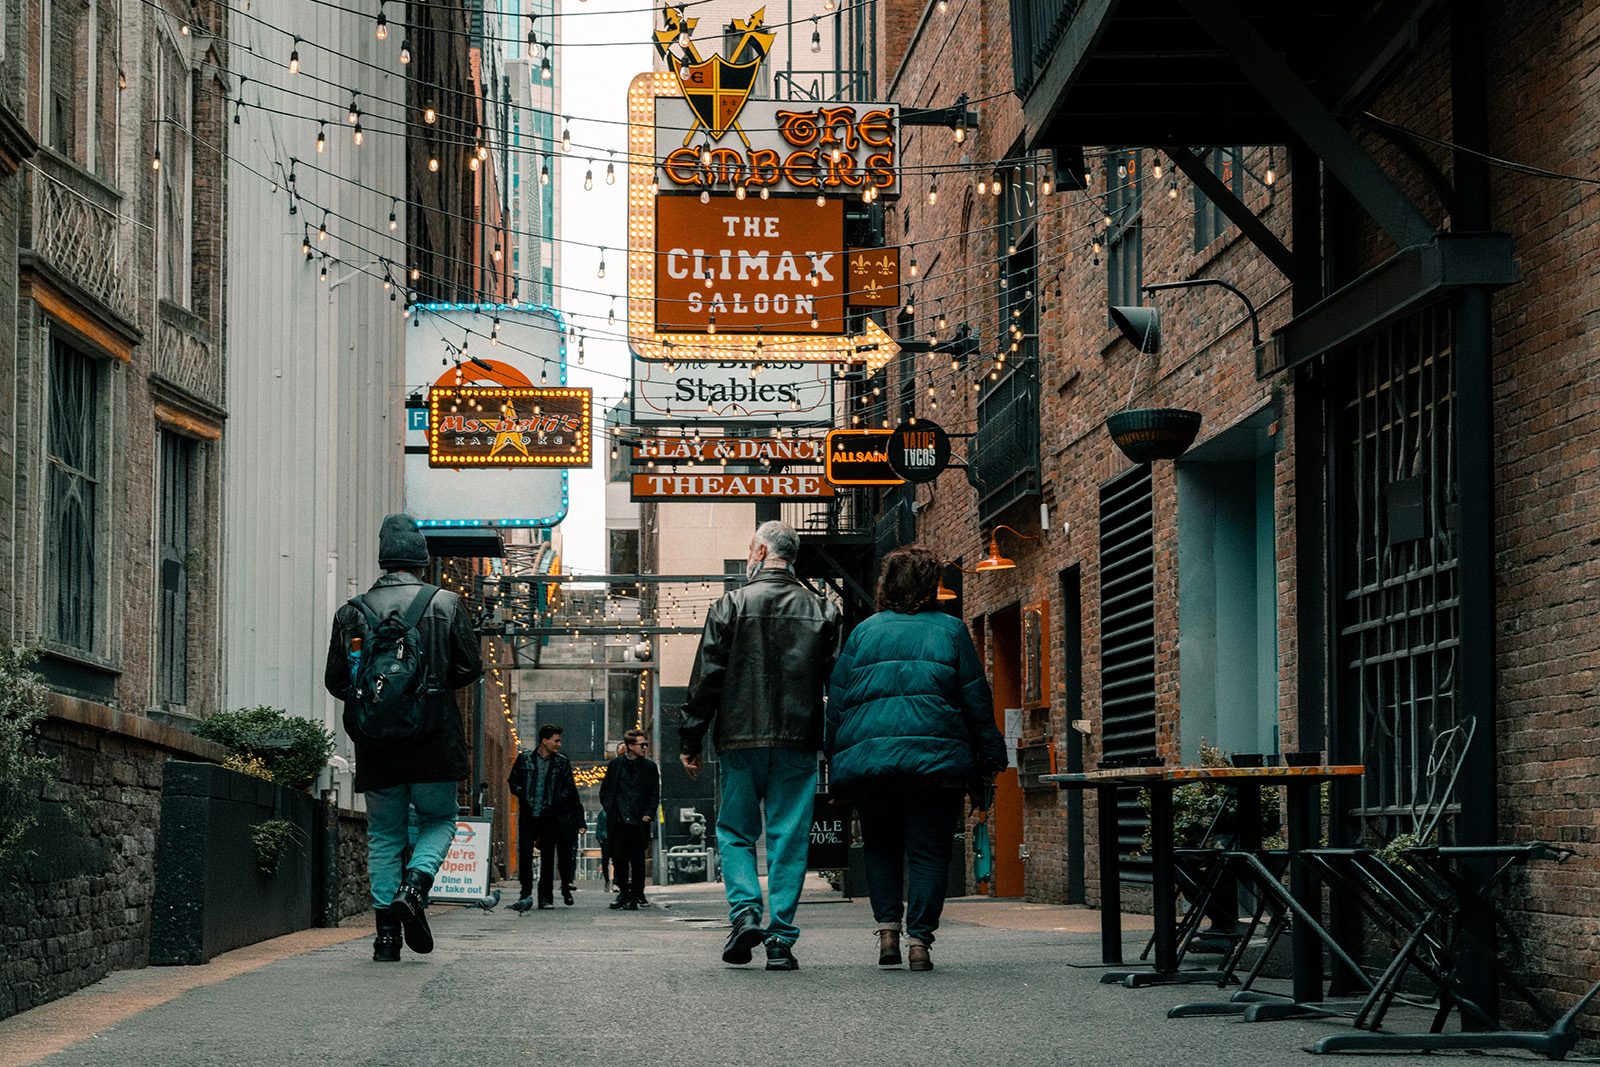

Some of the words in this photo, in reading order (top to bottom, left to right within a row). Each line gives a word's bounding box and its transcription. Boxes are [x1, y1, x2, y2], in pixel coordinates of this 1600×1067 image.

[775, 106, 896, 150] THE
[664, 145, 896, 188] EMBERS
[723, 216, 779, 237] THE
[667, 248, 834, 281] CLIMAX
[688, 292, 814, 314] SALOON
[675, 377, 793, 403] Stables
[439, 415, 490, 433] Ms.
[495, 414, 580, 433] Kelli's
[455, 436, 563, 446] KARAOKE
[639, 439, 708, 457] PLAY
[714, 440, 733, 457] &
[903, 431, 936, 449] VATOS
[648, 476, 820, 495] THEATRE
[442, 860, 477, 873] Open!
[441, 875, 462, 884] Dine
[464, 876, 473, 884] in
[445, 885, 465, 893] take
[467, 886, 482, 894] out
